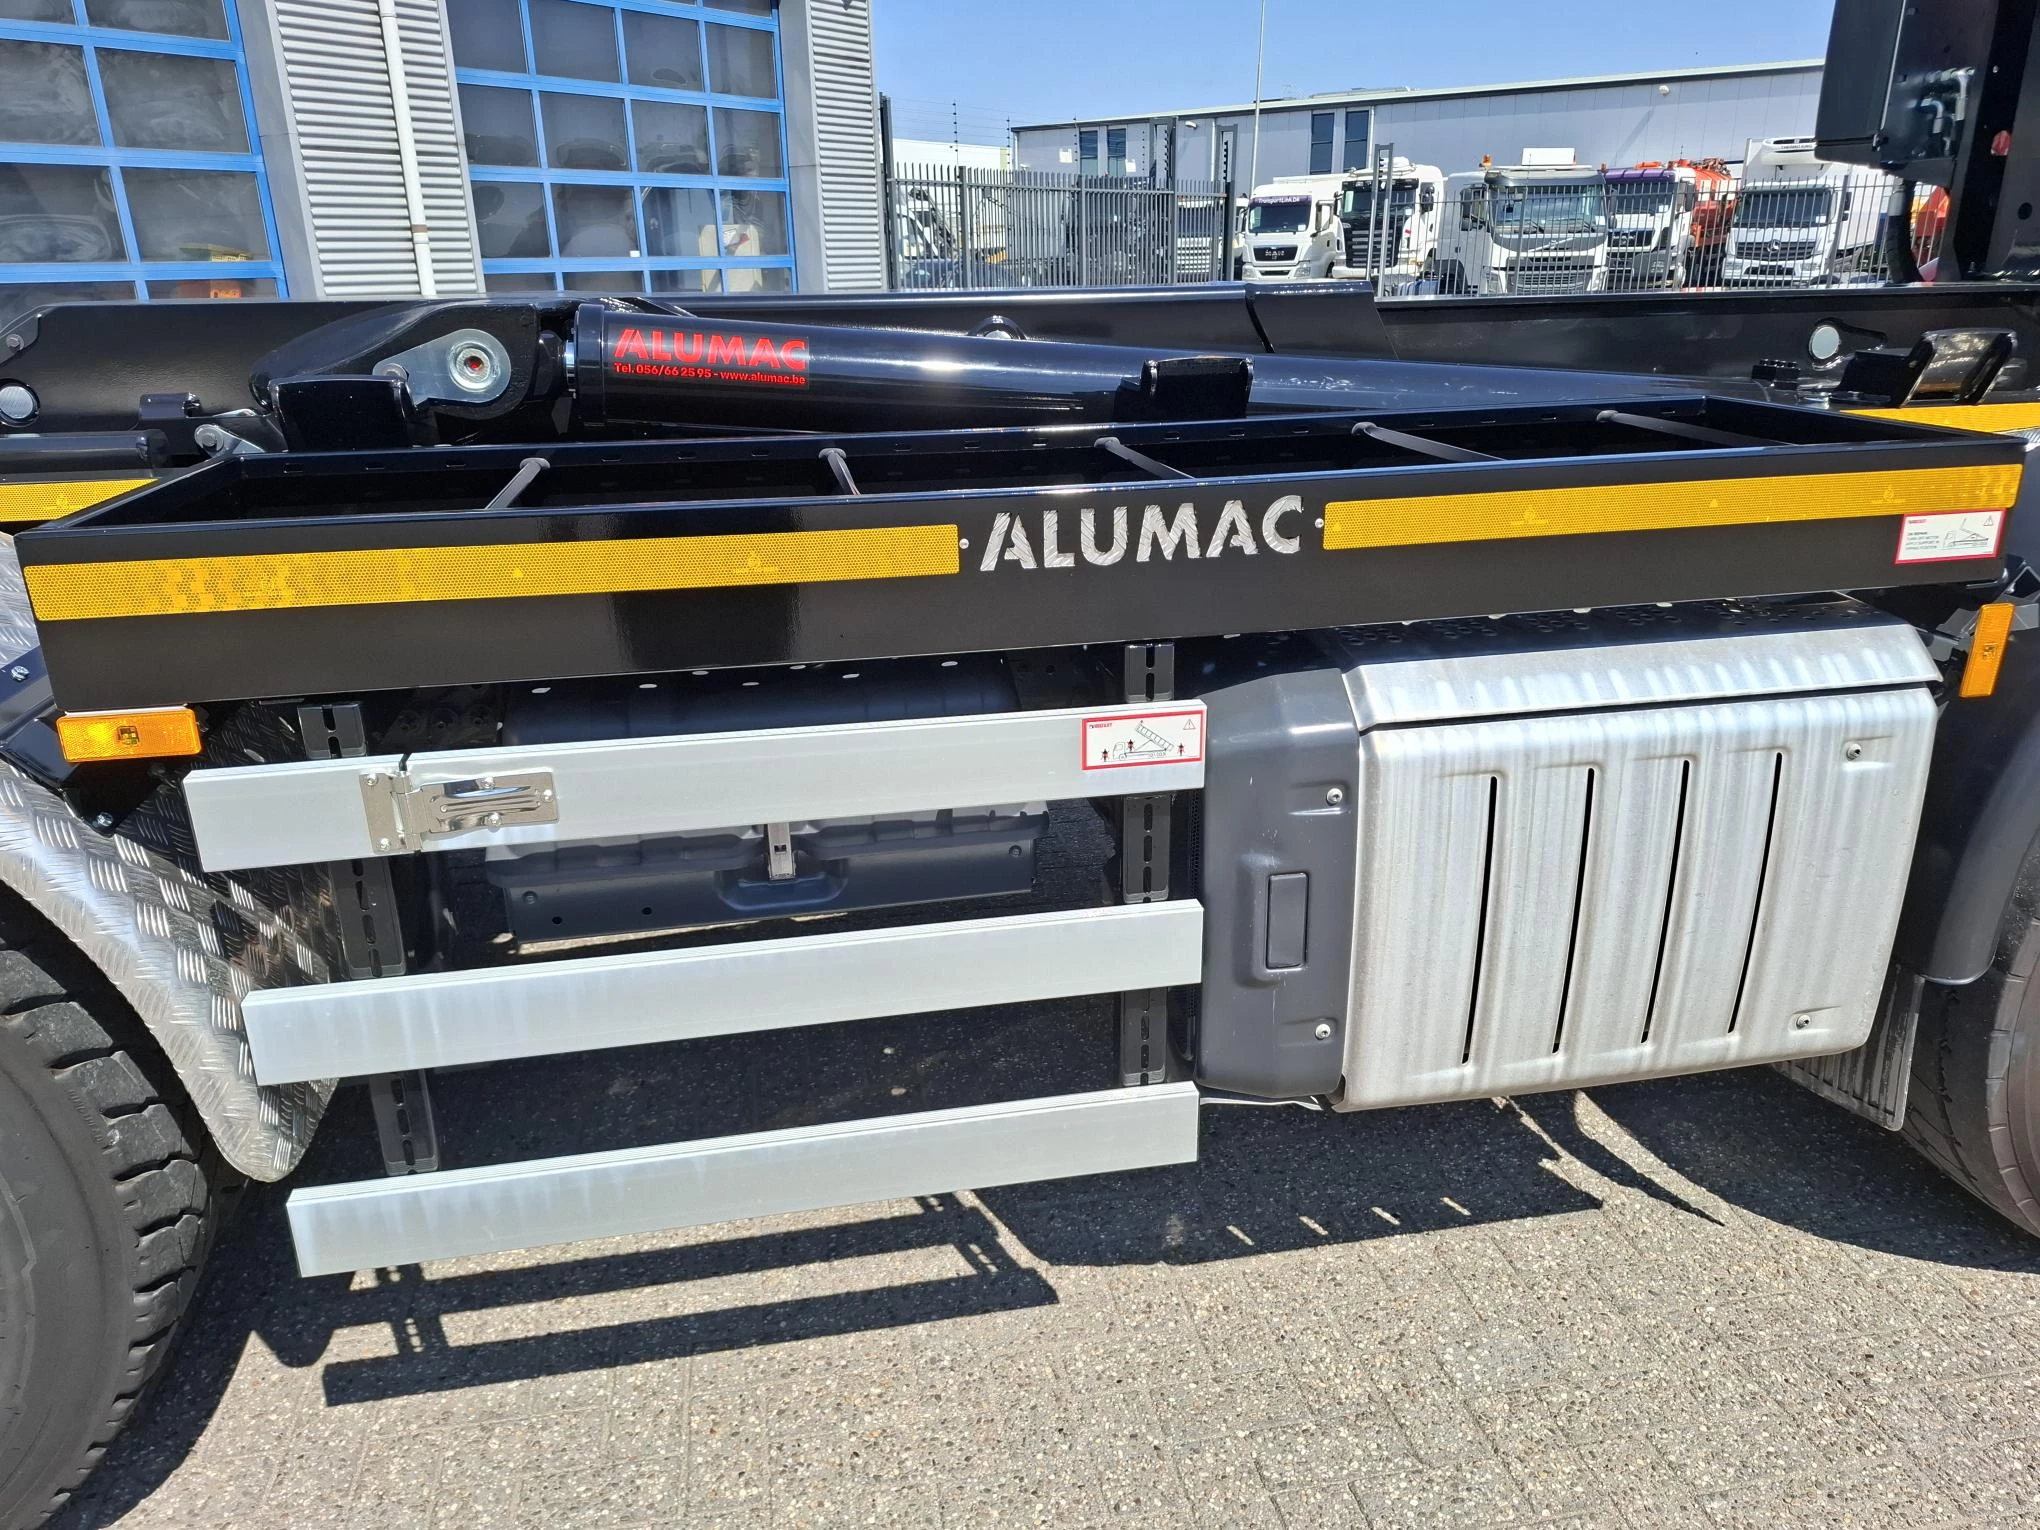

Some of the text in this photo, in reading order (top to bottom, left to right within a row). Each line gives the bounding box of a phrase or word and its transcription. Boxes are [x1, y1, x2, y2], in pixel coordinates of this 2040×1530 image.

[614, 328, 806, 369] ALUMAC
[614, 362, 634, 374] Tel.
[636, 365, 678, 377] 056/66
[720, 371, 806, 384] www.alumac.be
[979, 494, 1303, 572] ALUMAC
